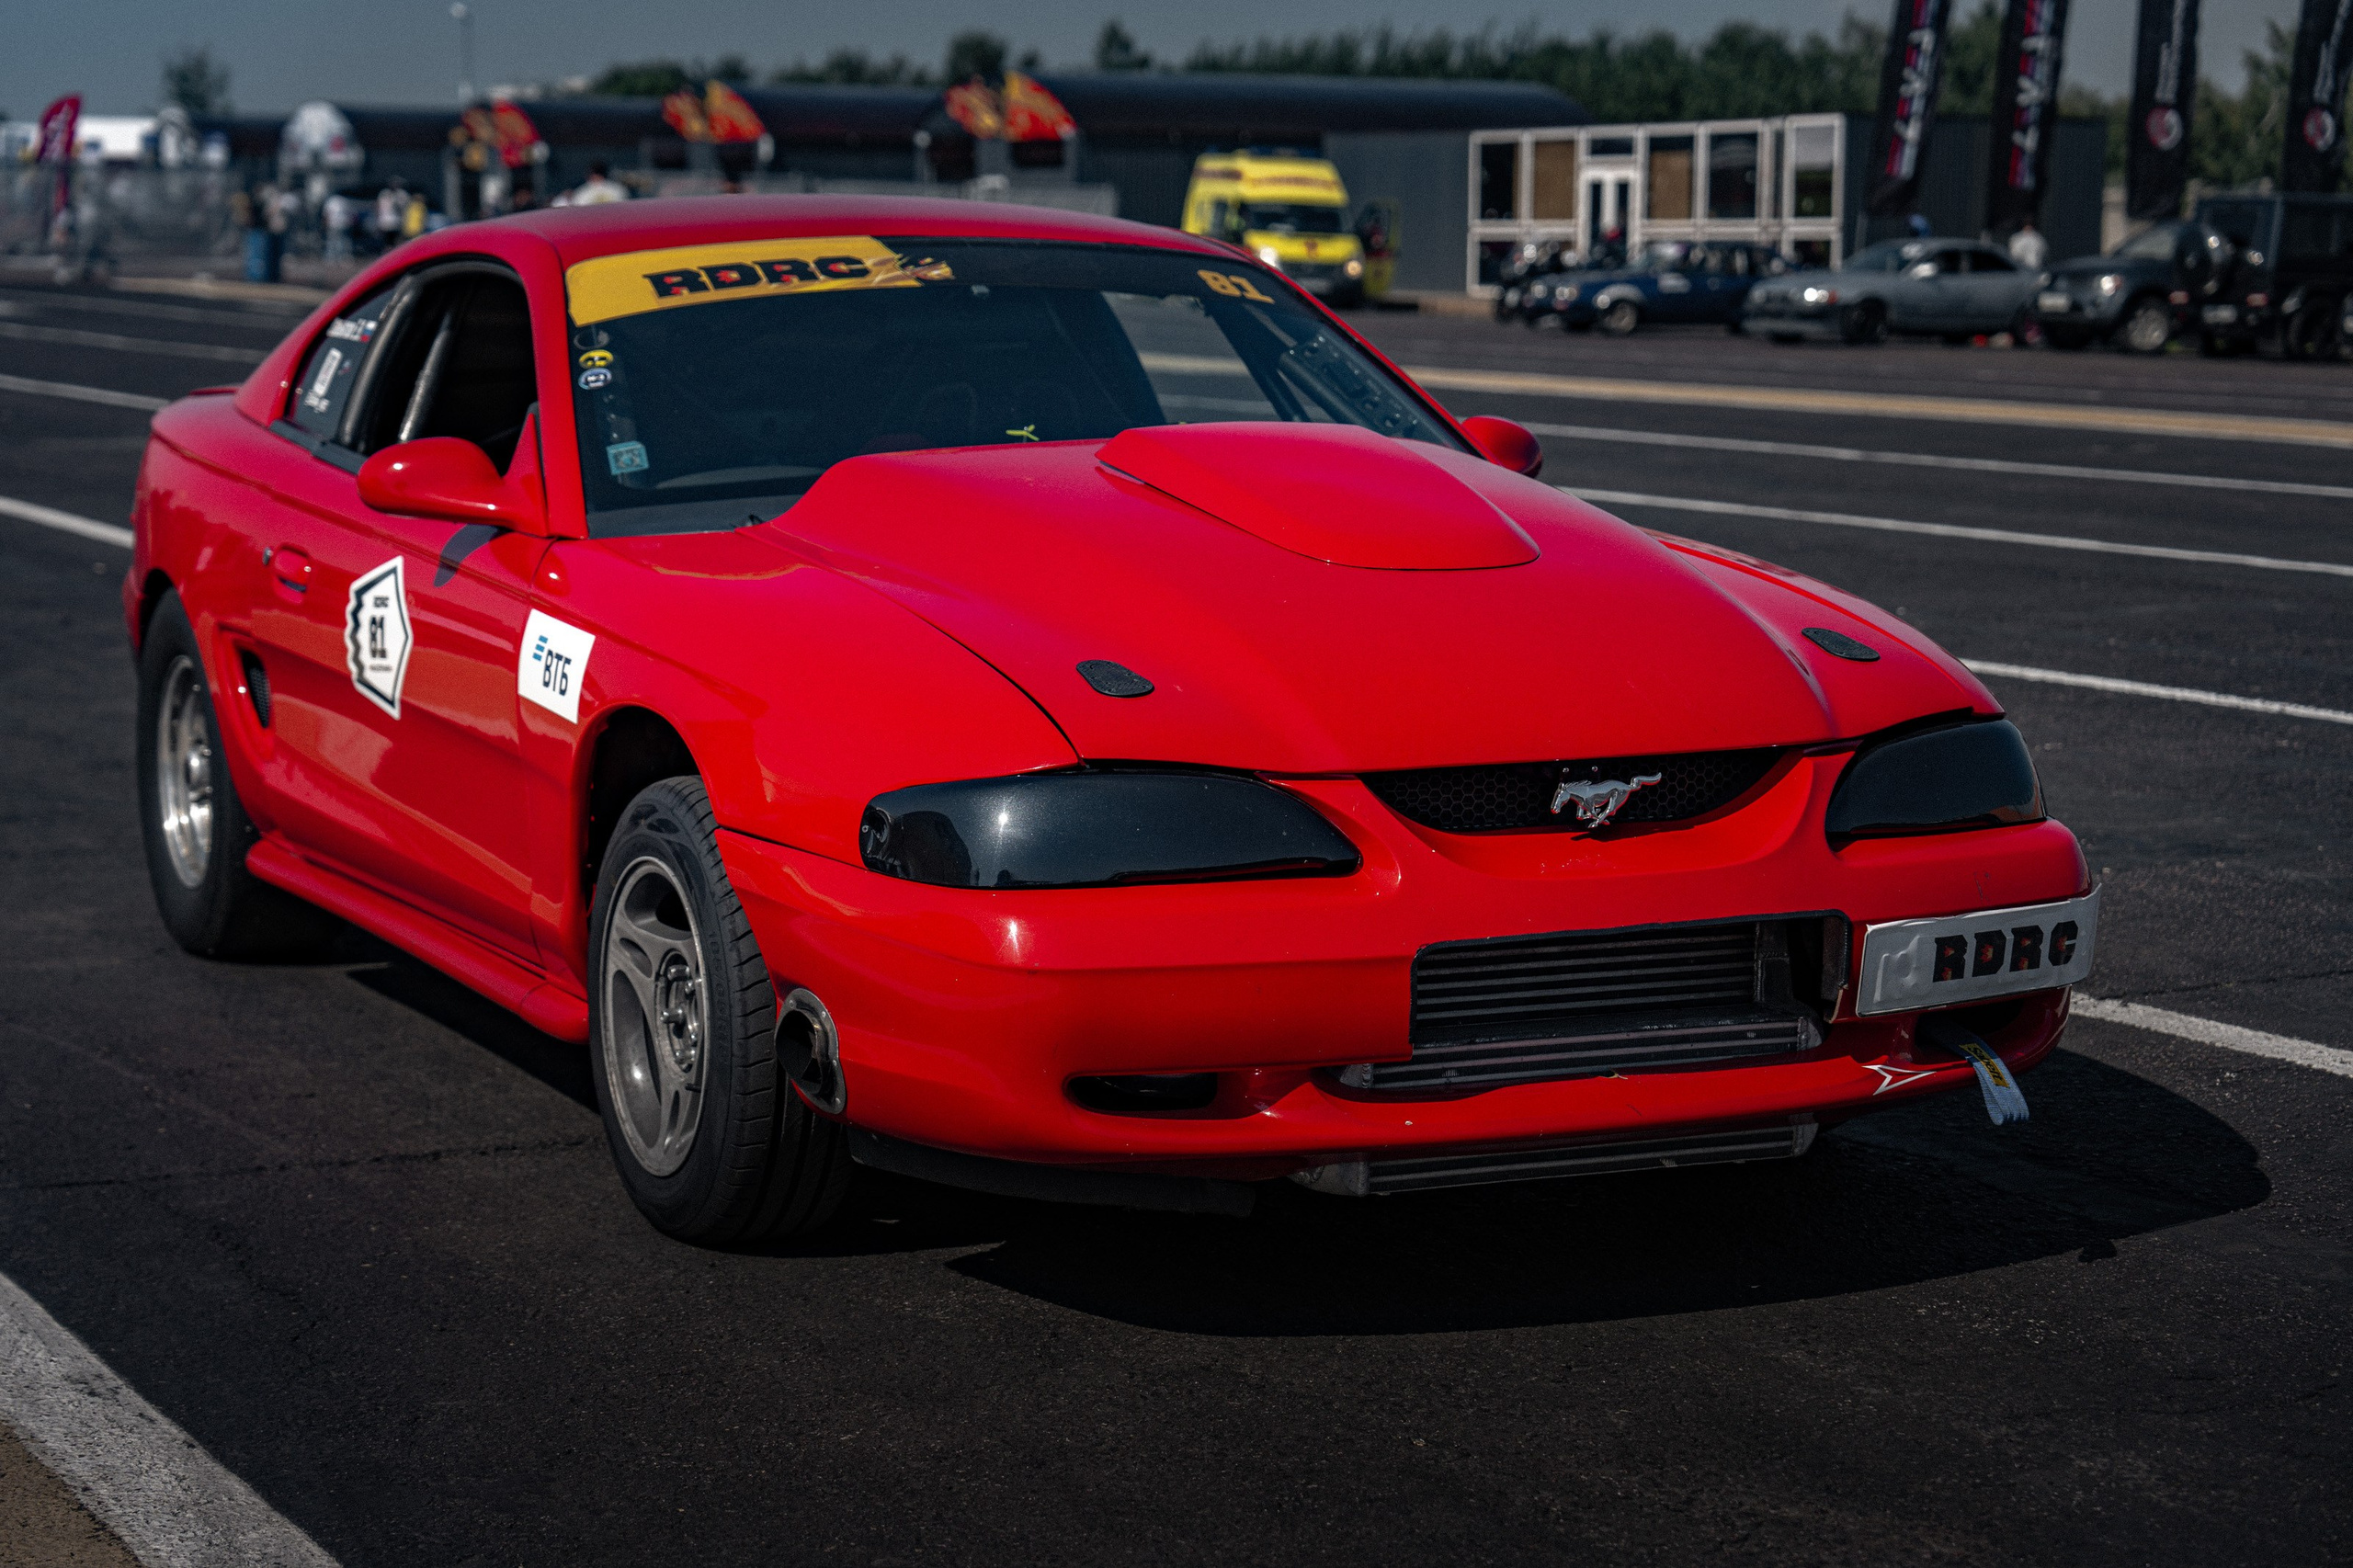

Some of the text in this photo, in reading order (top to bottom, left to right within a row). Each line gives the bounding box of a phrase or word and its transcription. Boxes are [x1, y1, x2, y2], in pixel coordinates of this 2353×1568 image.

[645, 256, 870, 299] RDRC
[1197, 269, 1275, 304] 81
[369, 615, 387, 658] 81
[542, 649, 572, 696] ВТБ
[1932, 920, 2079, 983] RDRC
